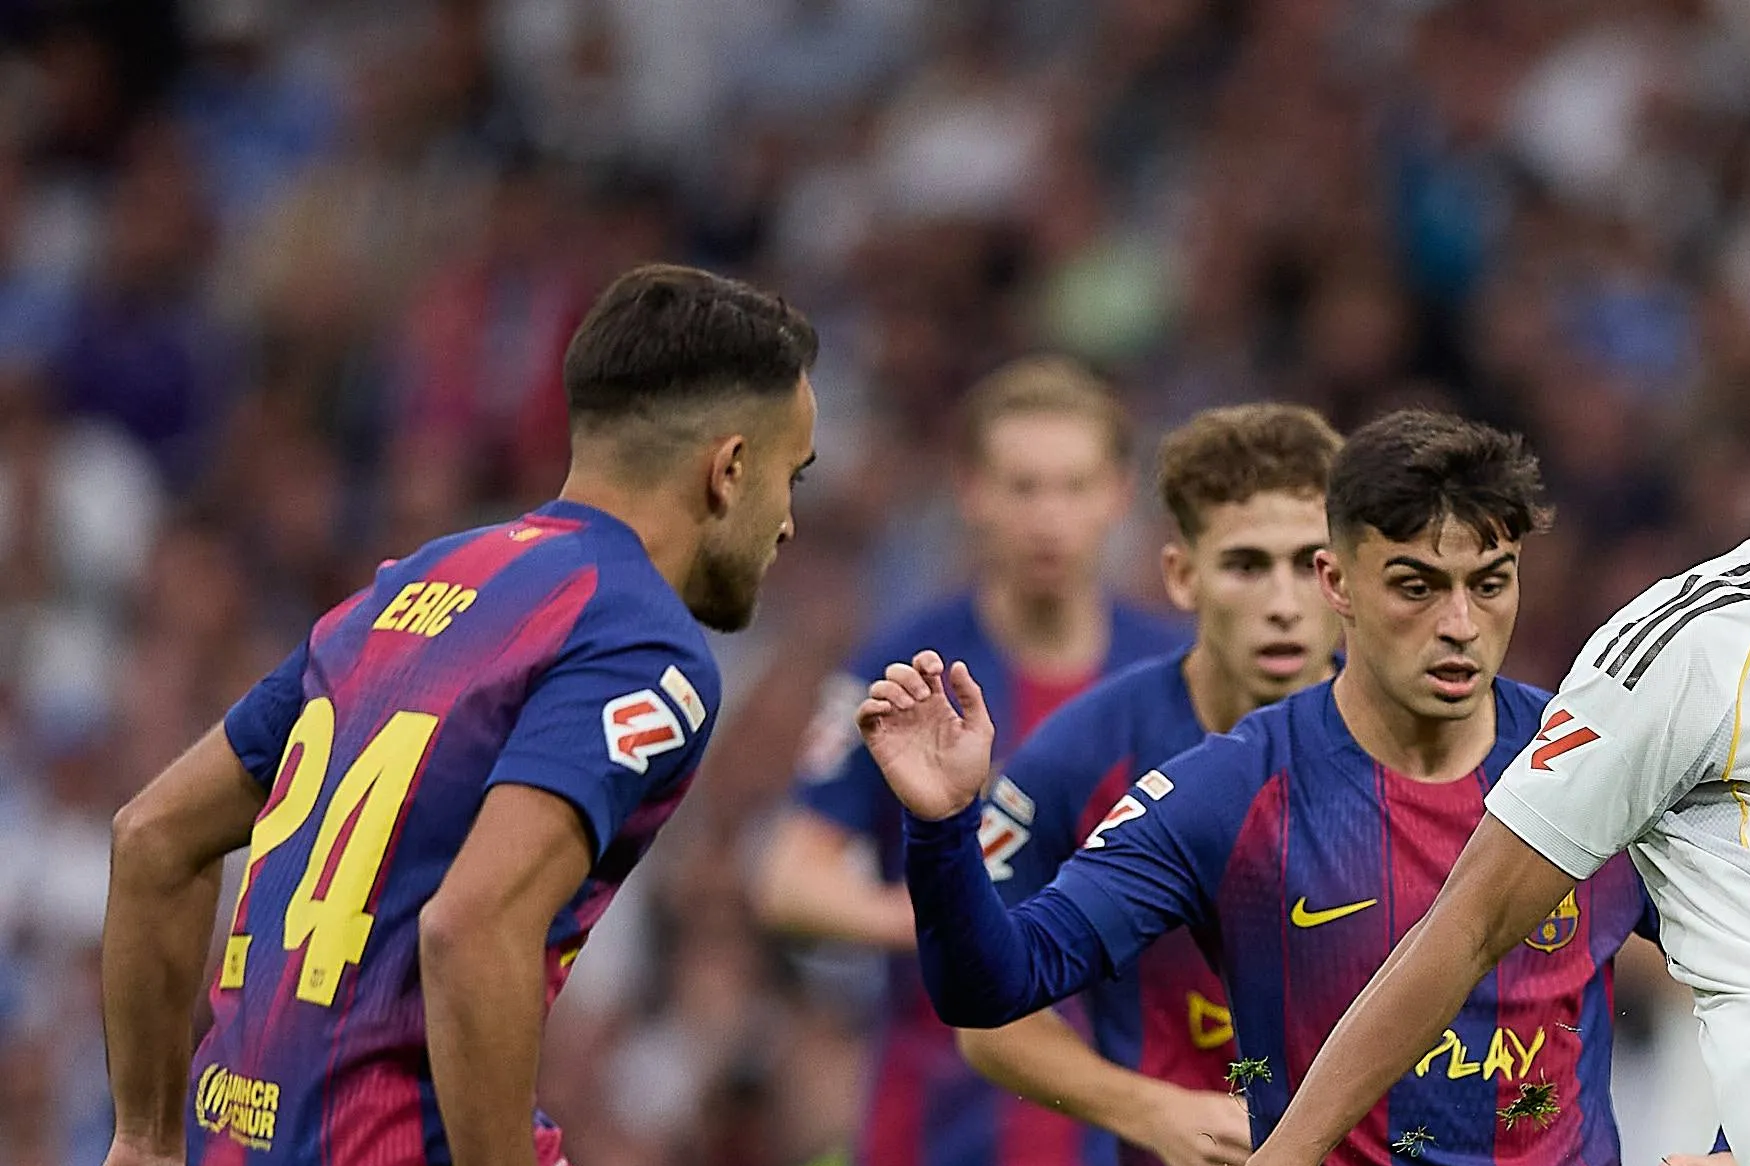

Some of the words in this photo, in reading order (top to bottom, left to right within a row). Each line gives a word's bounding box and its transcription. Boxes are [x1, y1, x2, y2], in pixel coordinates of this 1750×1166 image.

[372, 581, 479, 638] ERIC
[219, 696, 440, 1008] 24
[1414, 1025, 1546, 1081] PLAY
